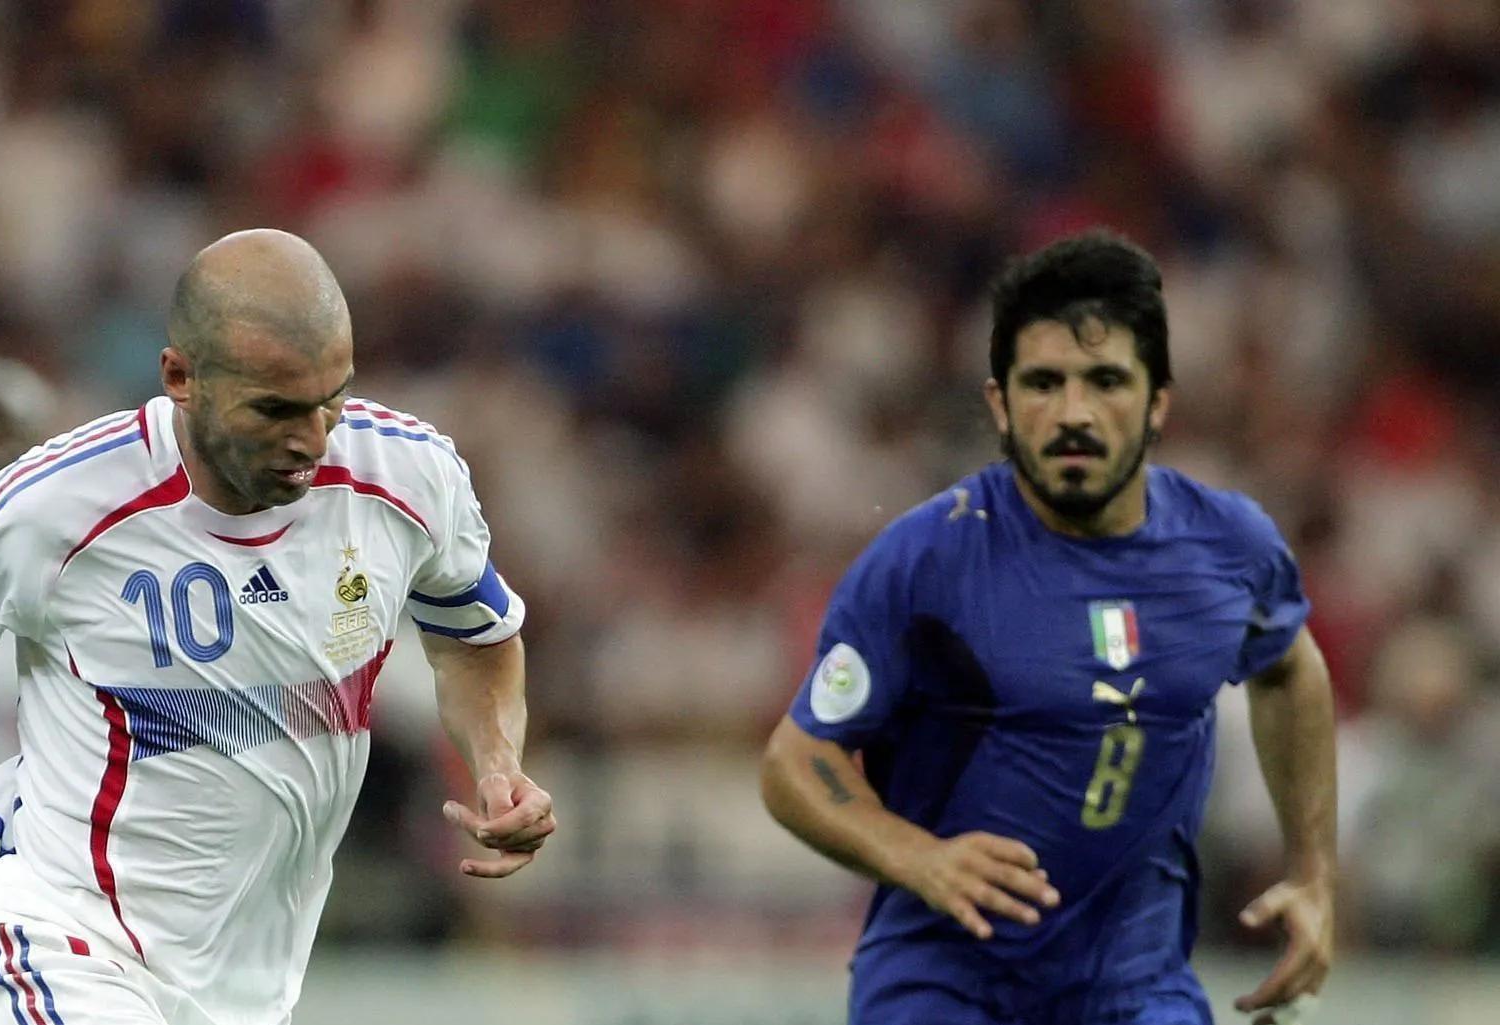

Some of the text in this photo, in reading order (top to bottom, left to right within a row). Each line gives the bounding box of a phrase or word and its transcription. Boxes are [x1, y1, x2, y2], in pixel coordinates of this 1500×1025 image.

[120, 561, 234, 668] 10
[239, 589, 289, 604] adidas
[1081, 725, 1144, 829] 8
